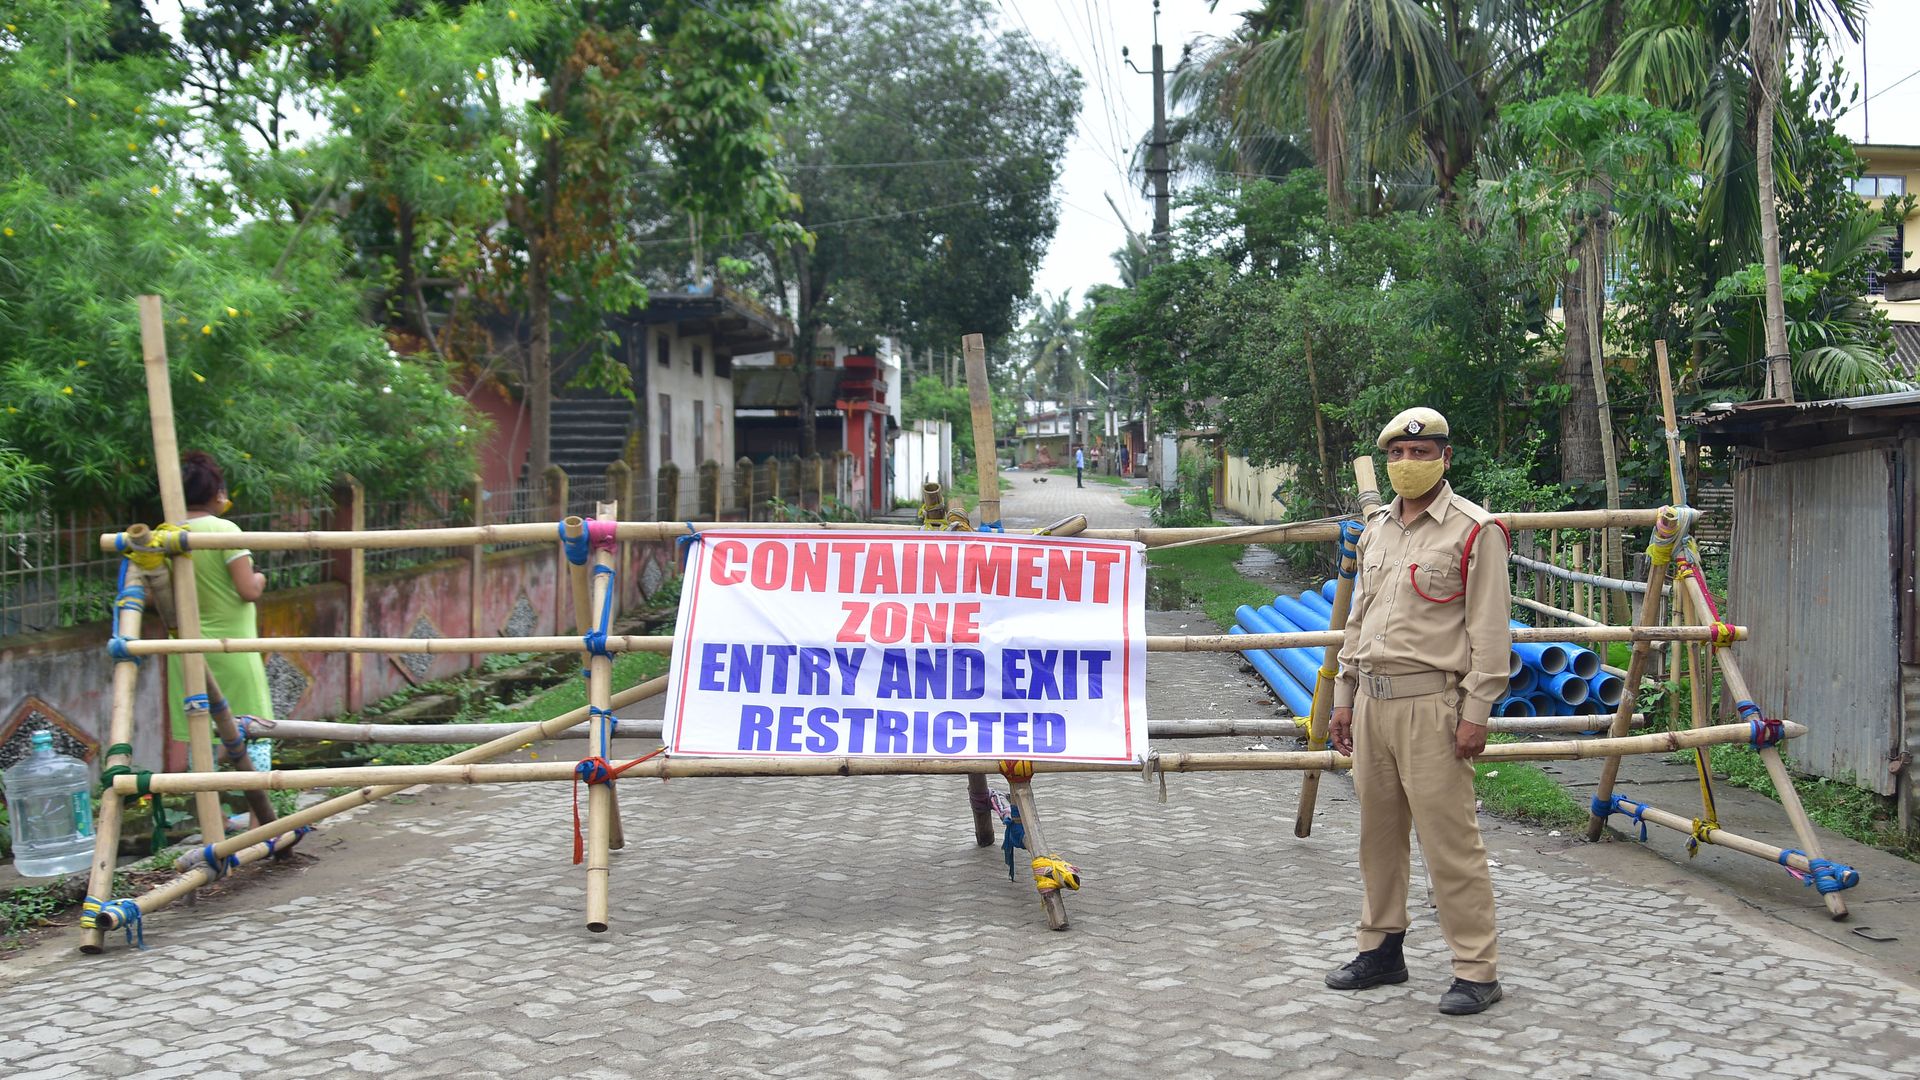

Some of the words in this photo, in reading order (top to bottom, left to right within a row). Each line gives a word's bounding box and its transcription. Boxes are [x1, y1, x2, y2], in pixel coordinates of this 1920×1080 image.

[710, 541, 1120, 604] CONTAINMENT
[836, 602, 981, 643] ZONE
[699, 643, 866, 696] ENTRY
[877, 648, 985, 700] AND
[1002, 648, 1111, 700] EXIT
[738, 705, 1066, 754] RESTRICTED
